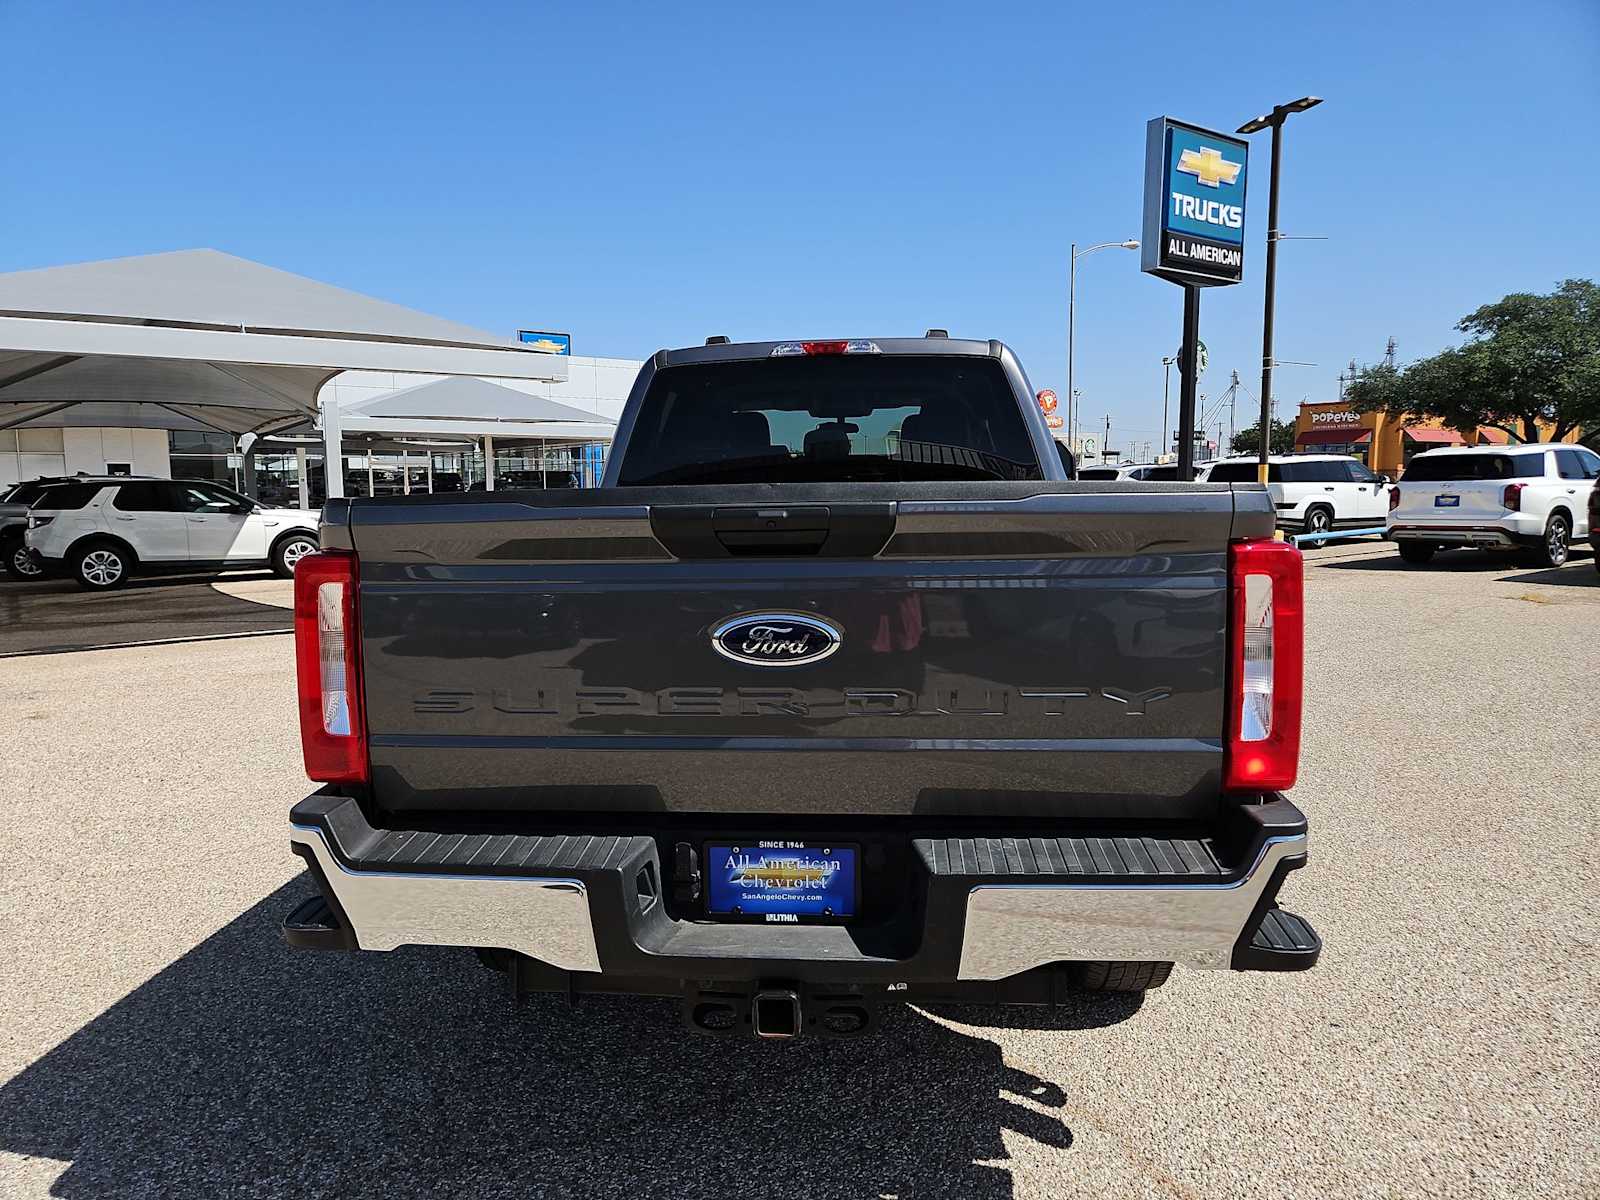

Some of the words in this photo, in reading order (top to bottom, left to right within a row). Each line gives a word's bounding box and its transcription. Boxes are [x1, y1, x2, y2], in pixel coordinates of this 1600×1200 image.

[1172, 192, 1242, 228] TRUCKS
[1169, 239, 1189, 256] ALL
[1190, 243, 1241, 266] AMERICAN
[741, 625, 810, 654] Ford
[413, 686, 811, 717] SUPER
[843, 686, 1173, 717] DUTY
[758, 841, 784, 849] SINCE
[786, 841, 805, 849] 1946
[725, 855, 749, 869] All
[758, 856, 840, 870] American
[741, 874, 827, 889] Chevrolet
[742, 893, 822, 901] SanAngeloChevy.com
[773, 913, 799, 922] LITHIA
